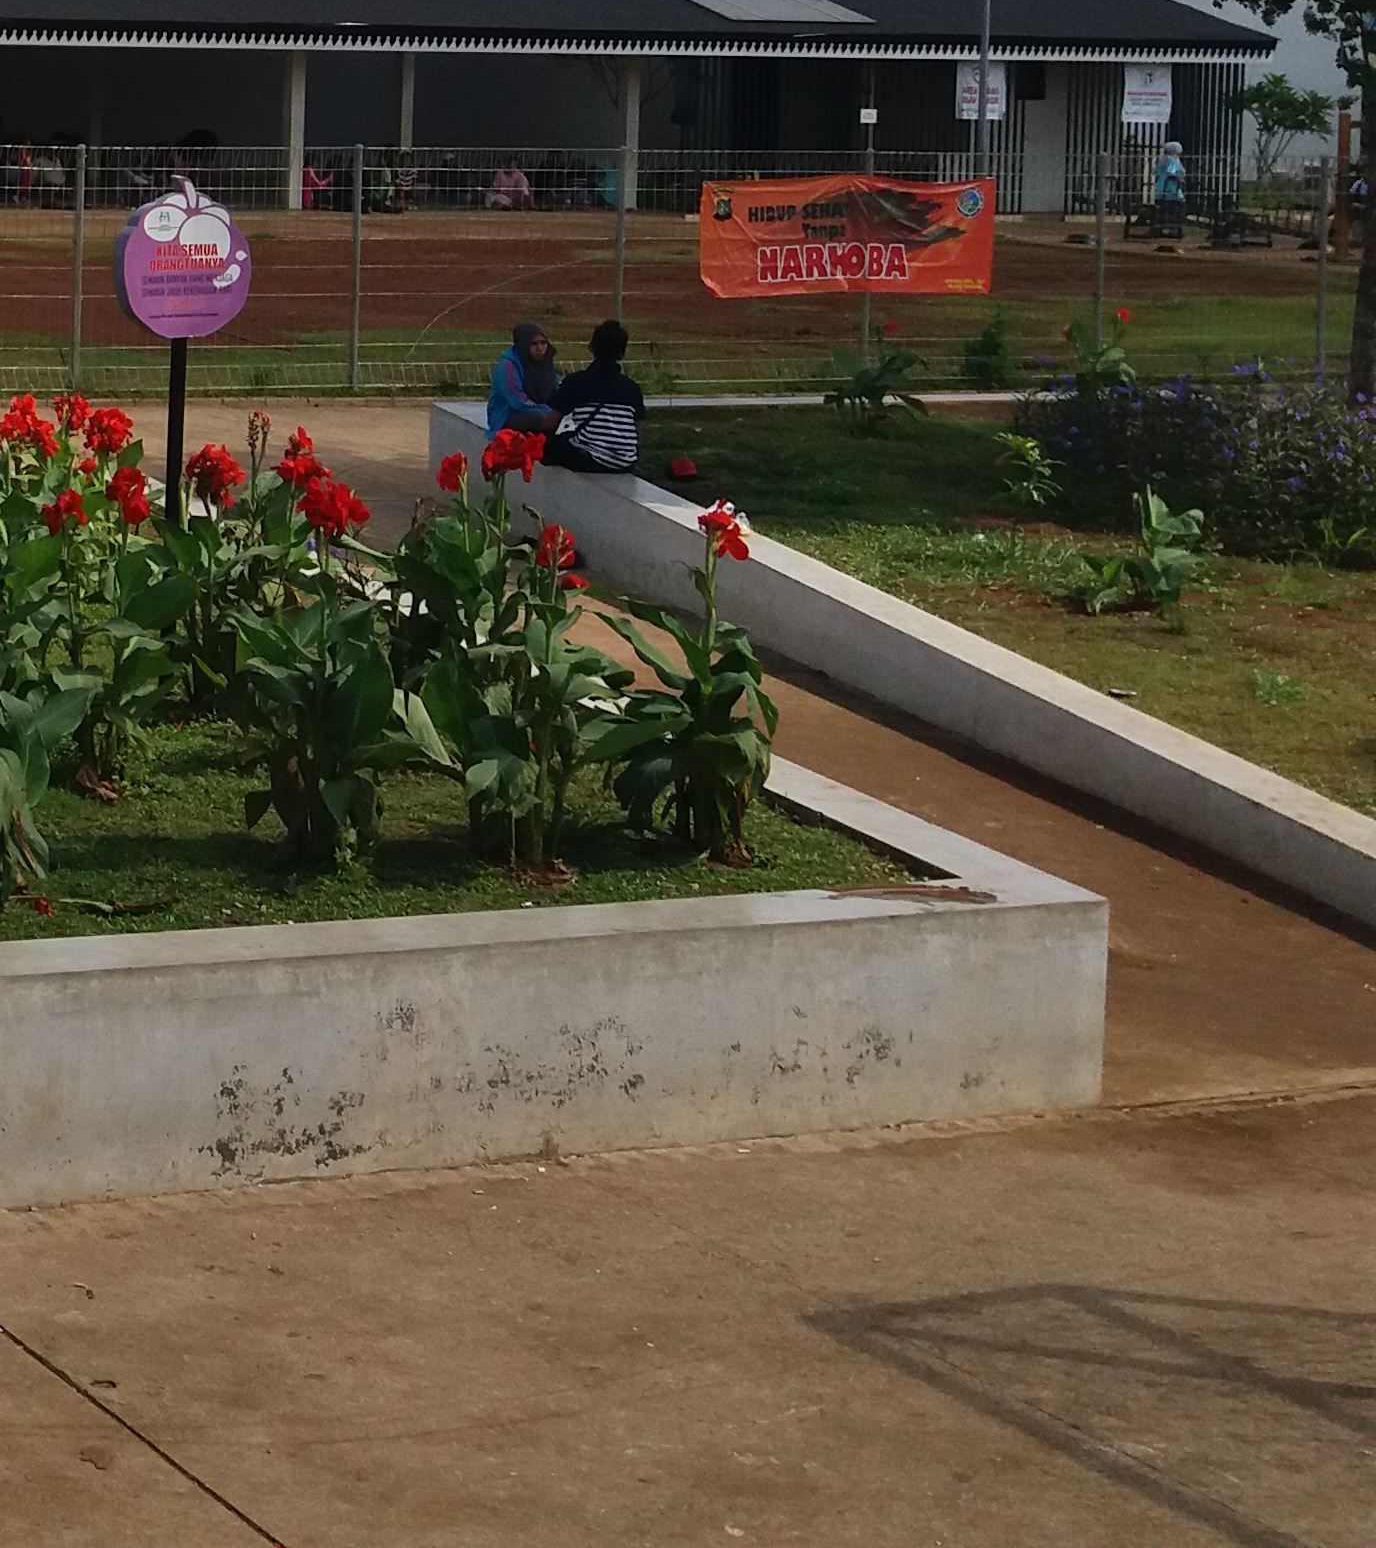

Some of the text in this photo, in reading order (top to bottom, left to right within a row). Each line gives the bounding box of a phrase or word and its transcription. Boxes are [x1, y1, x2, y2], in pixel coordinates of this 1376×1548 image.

[748, 205, 796, 223] HIDUP
[802, 223, 845, 241] Tanpa
[156, 243, 218, 257] KITA SEMUA
[150, 258, 224, 271] ORANGTUANYA
[757, 242, 909, 284] NARKOBA
